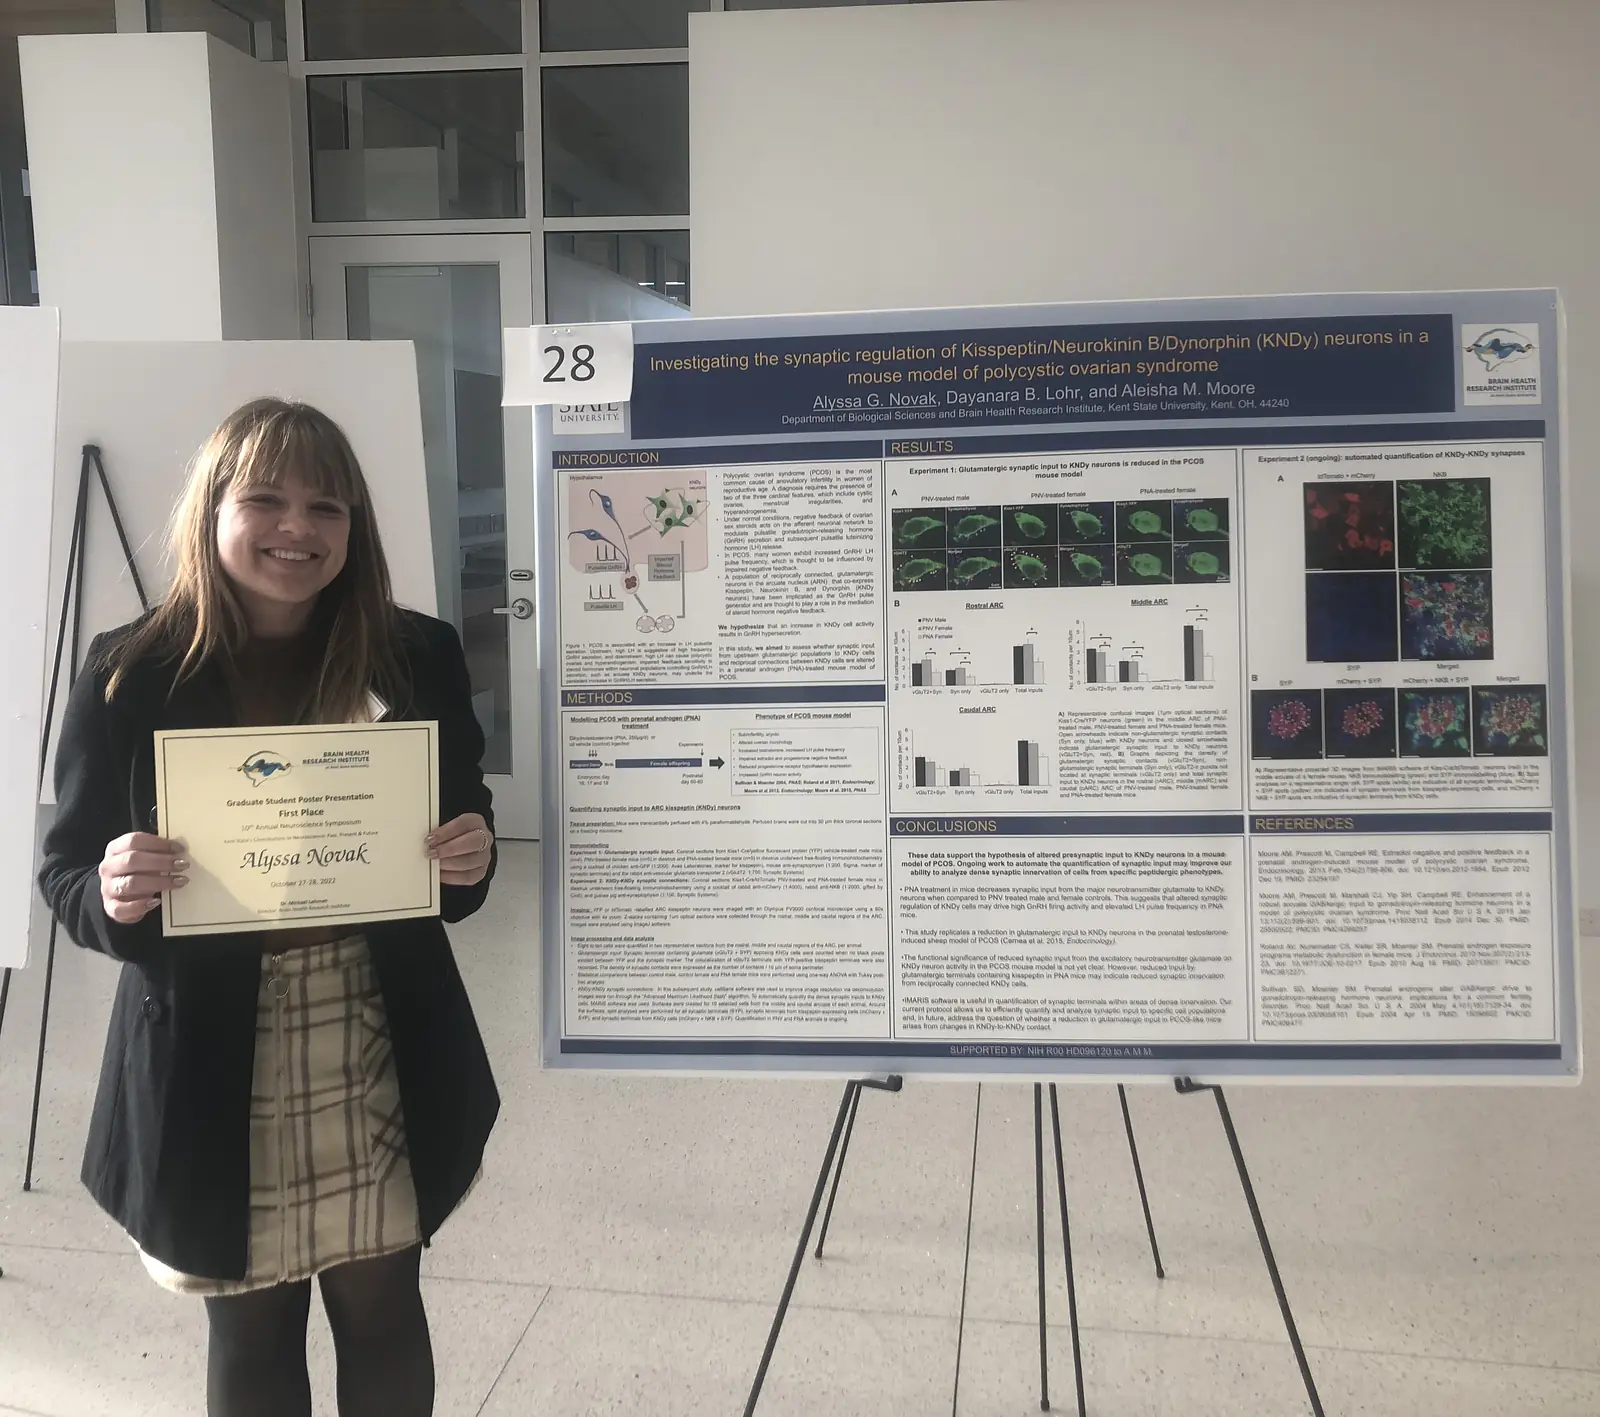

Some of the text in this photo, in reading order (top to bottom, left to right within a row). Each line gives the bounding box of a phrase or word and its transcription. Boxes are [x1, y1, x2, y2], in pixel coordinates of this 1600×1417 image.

[649, 330, 1430, 375] Investigating the synaptic regulation of Kisspeptin/Neurokinin B/Dynorphin (KNDy) neurons in a
[542, 344, 595, 383] 28
[847, 357, 1219, 384] mouse model of polycystic ovarian syndrome
[812, 382, 1255, 412] Alyssa G. Novak, Dayanara B. Lohr, and Aleisha M. Moore
[781, 412, 835, 427] Department
[836, 411, 847, 422] of
[848, 409, 892, 424] Biological
[894, 408, 936, 420] Sciences
[938, 407, 956, 418] and
[958, 406, 985, 417] Brain
[985, 405, 1017, 417] Health
[1018, 403, 1063, 415] Research
[1108, 401, 1130, 413] Kent
[1132, 401, 1157, 412] State
[1259, 397, 1289, 409] 44240
[891, 440, 953, 454] RESULTS
[558, 452, 660, 466] INTRODUCTION
[1258, 449, 1526, 465] Experiment 2 (ongoing): automated quantification of KNDy-KNDy synapses
[909, 457, 1205, 477] Experiment 1: Glutamatergic synaptic input to KNDy neurons is reduced in the PCOS
[1060, 469, 1083, 478] model
[567, 691, 633, 704] METHODS
[265, 797, 296, 805] Student
[325, 793, 374, 802] Presentation
[279, 808, 324, 818] First Place
[280, 821, 323, 829] Neuroscience
[324, 819, 362, 828] Symposium
[895, 820, 997, 833] CONCLUSIONS
[1255, 817, 1354, 829] REFERENCES
[240, 842, 371, 875] Alyssa Novak
[908, 851, 928, 859] These
[929, 851, 945, 859] data
[946, 851, 973, 860] support
[974, 851, 986, 859] the
[987, 851, 1026, 860] hypothesis
[1061, 851, 1103, 860] presynaptic
[1104, 851, 1124, 860] input
[1133, 851, 1154, 860] KNDy
[1186, 850, 1194, 858] in
[901, 859, 923, 867] model
[956, 860, 986, 869] Ongoing
[1049, 859, 1061, 867] the
[1062, 859, 1111, 869] quantification
[1111, 859, 1120, 867] of
[1120, 859, 1151, 868] synaptic
[1152, 859, 1172, 868] input
[1172, 860, 1188, 868] may
[1189, 859, 1219, 868] improve
[270, 879, 297, 888] October
[320, 877, 336, 885] 2022
[950, 1045, 1008, 1055] SUPPORTED
[1027, 1046, 1044, 1055] NIH
[1045, 1046, 1064, 1055] R00
